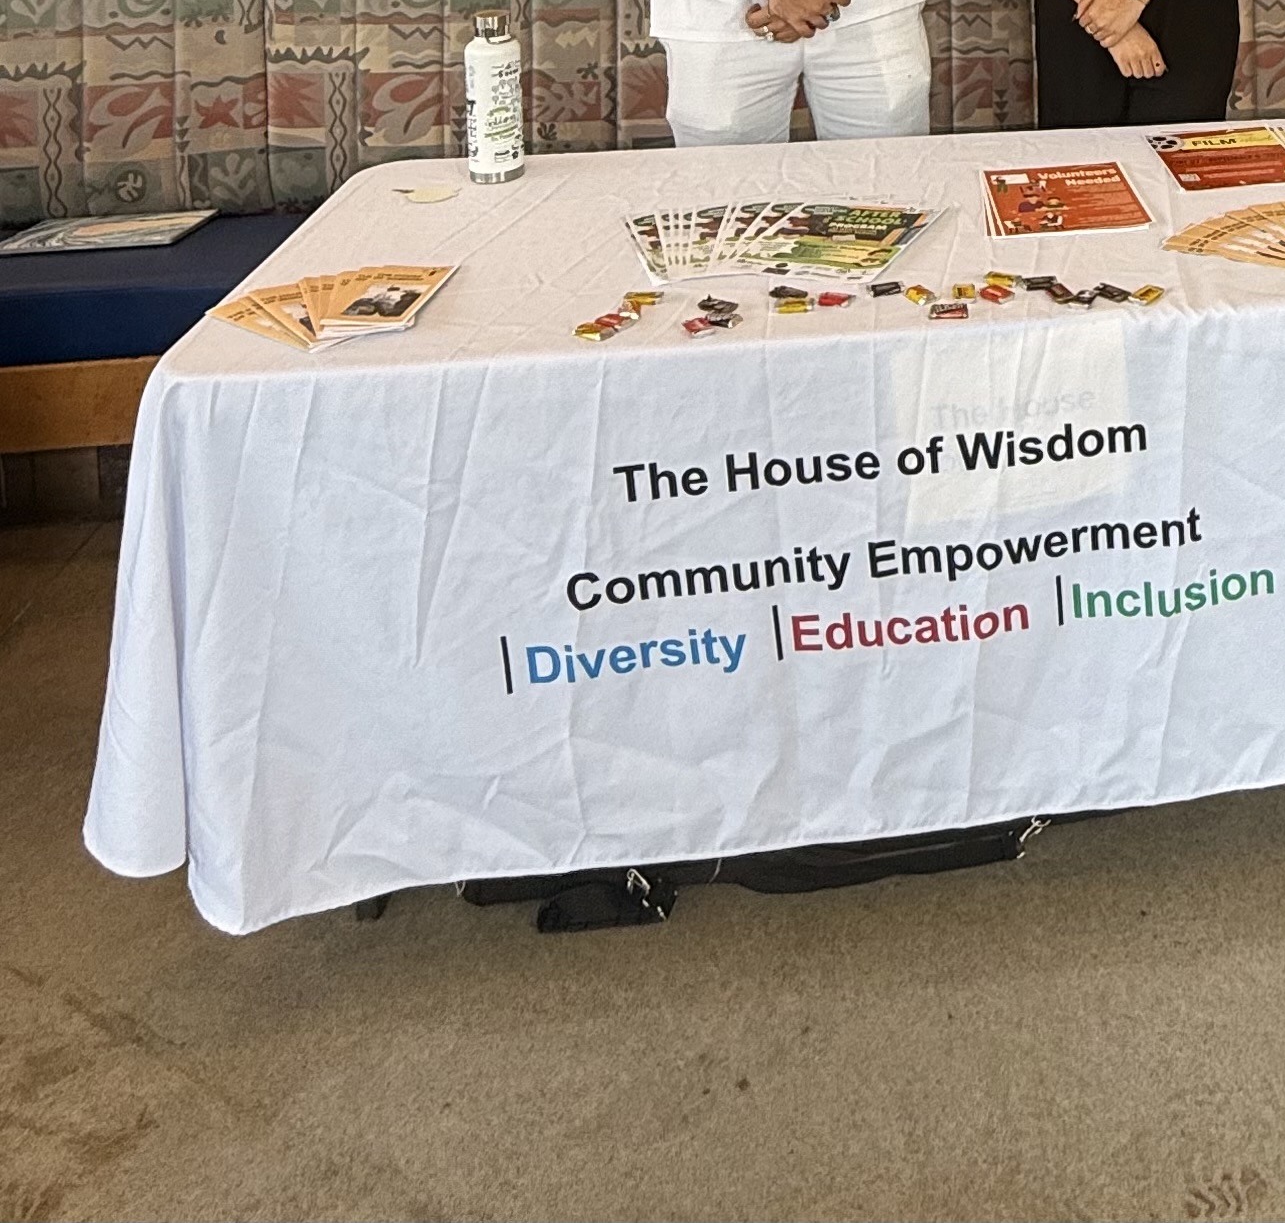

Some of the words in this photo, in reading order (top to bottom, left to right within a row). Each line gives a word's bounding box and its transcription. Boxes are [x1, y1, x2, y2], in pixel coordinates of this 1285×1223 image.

[1191, 138, 1237, 147] FILM
[1037, 168, 1117, 180] Volunteers
[1065, 175, 1121, 186] Needed
[613, 463, 708, 502] The
[726, 452, 880, 492] House
[898, 436, 943, 475] of
[956, 424, 1146, 470] Wisdom
[567, 547, 850, 614] Community
[868, 508, 1202, 585] Empowerment
[526, 629, 746, 683] Diversity
[792, 605, 1029, 651] Education
[1073, 569, 1274, 618] Inclusion
